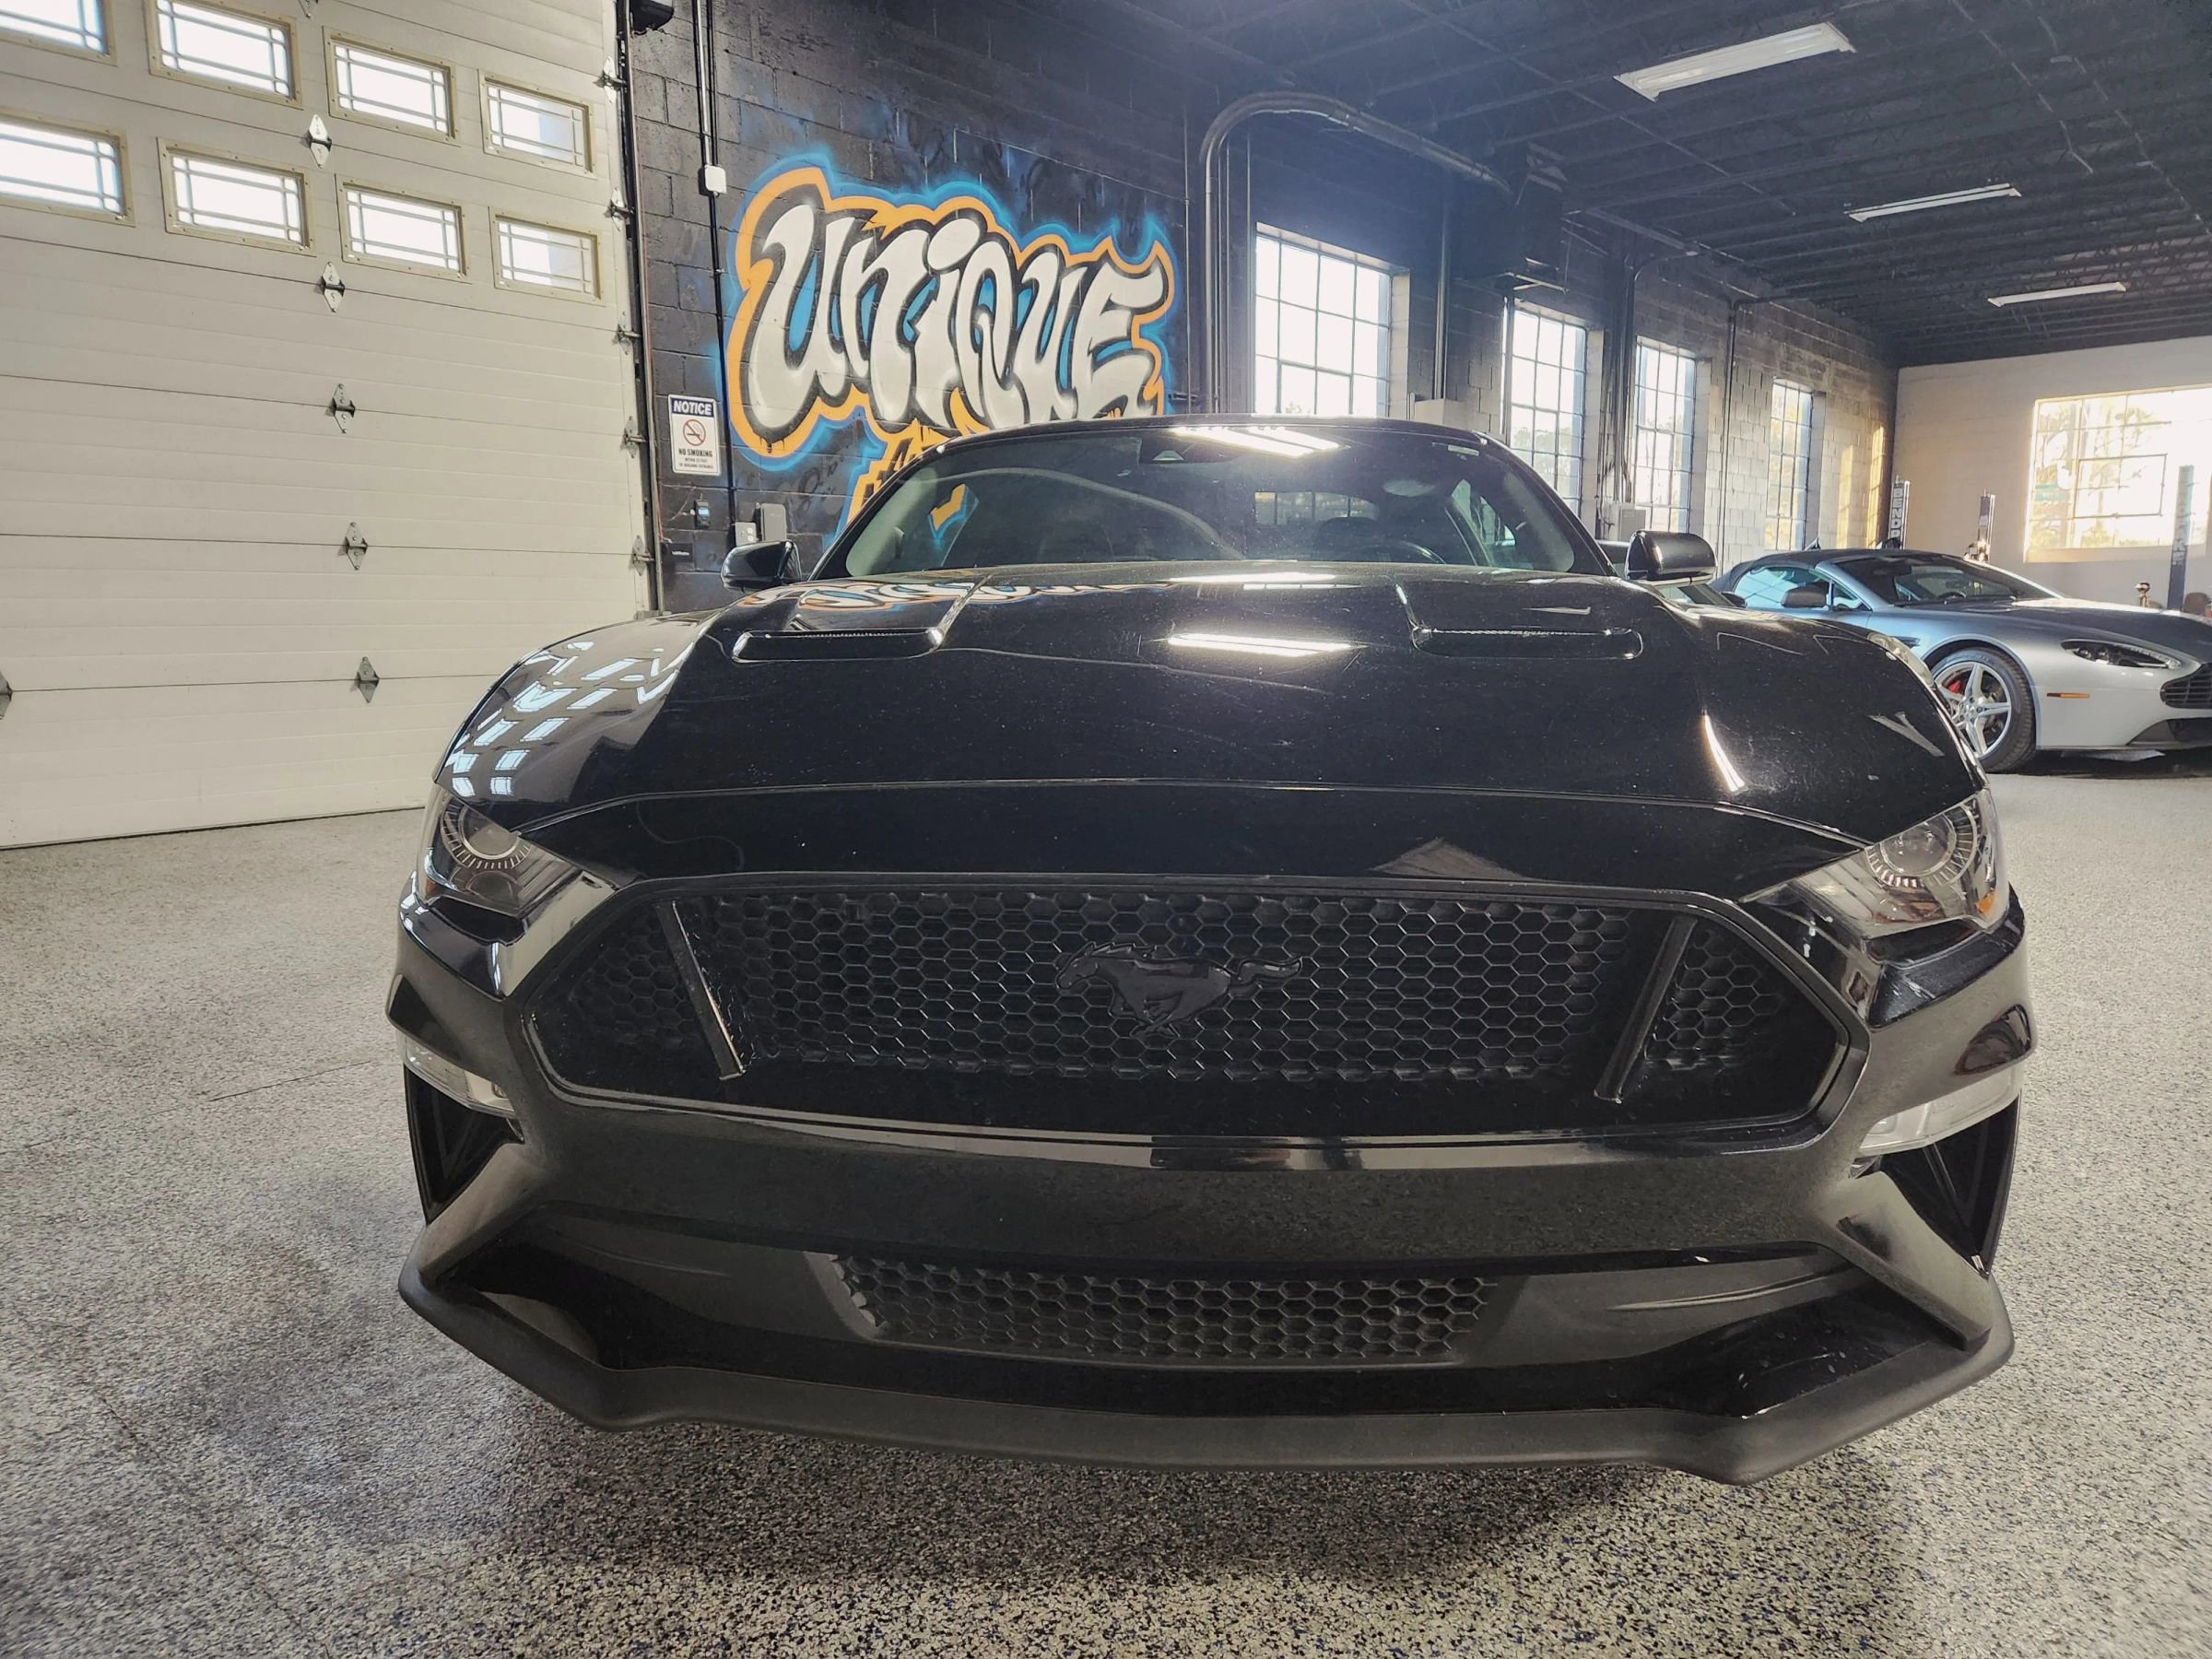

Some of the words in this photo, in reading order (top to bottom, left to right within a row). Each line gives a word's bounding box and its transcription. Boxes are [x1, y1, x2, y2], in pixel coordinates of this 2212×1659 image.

[673, 400, 712, 416] NOTICE
[678, 448, 687, 456] NO
[687, 448, 713, 457] SMOKING
